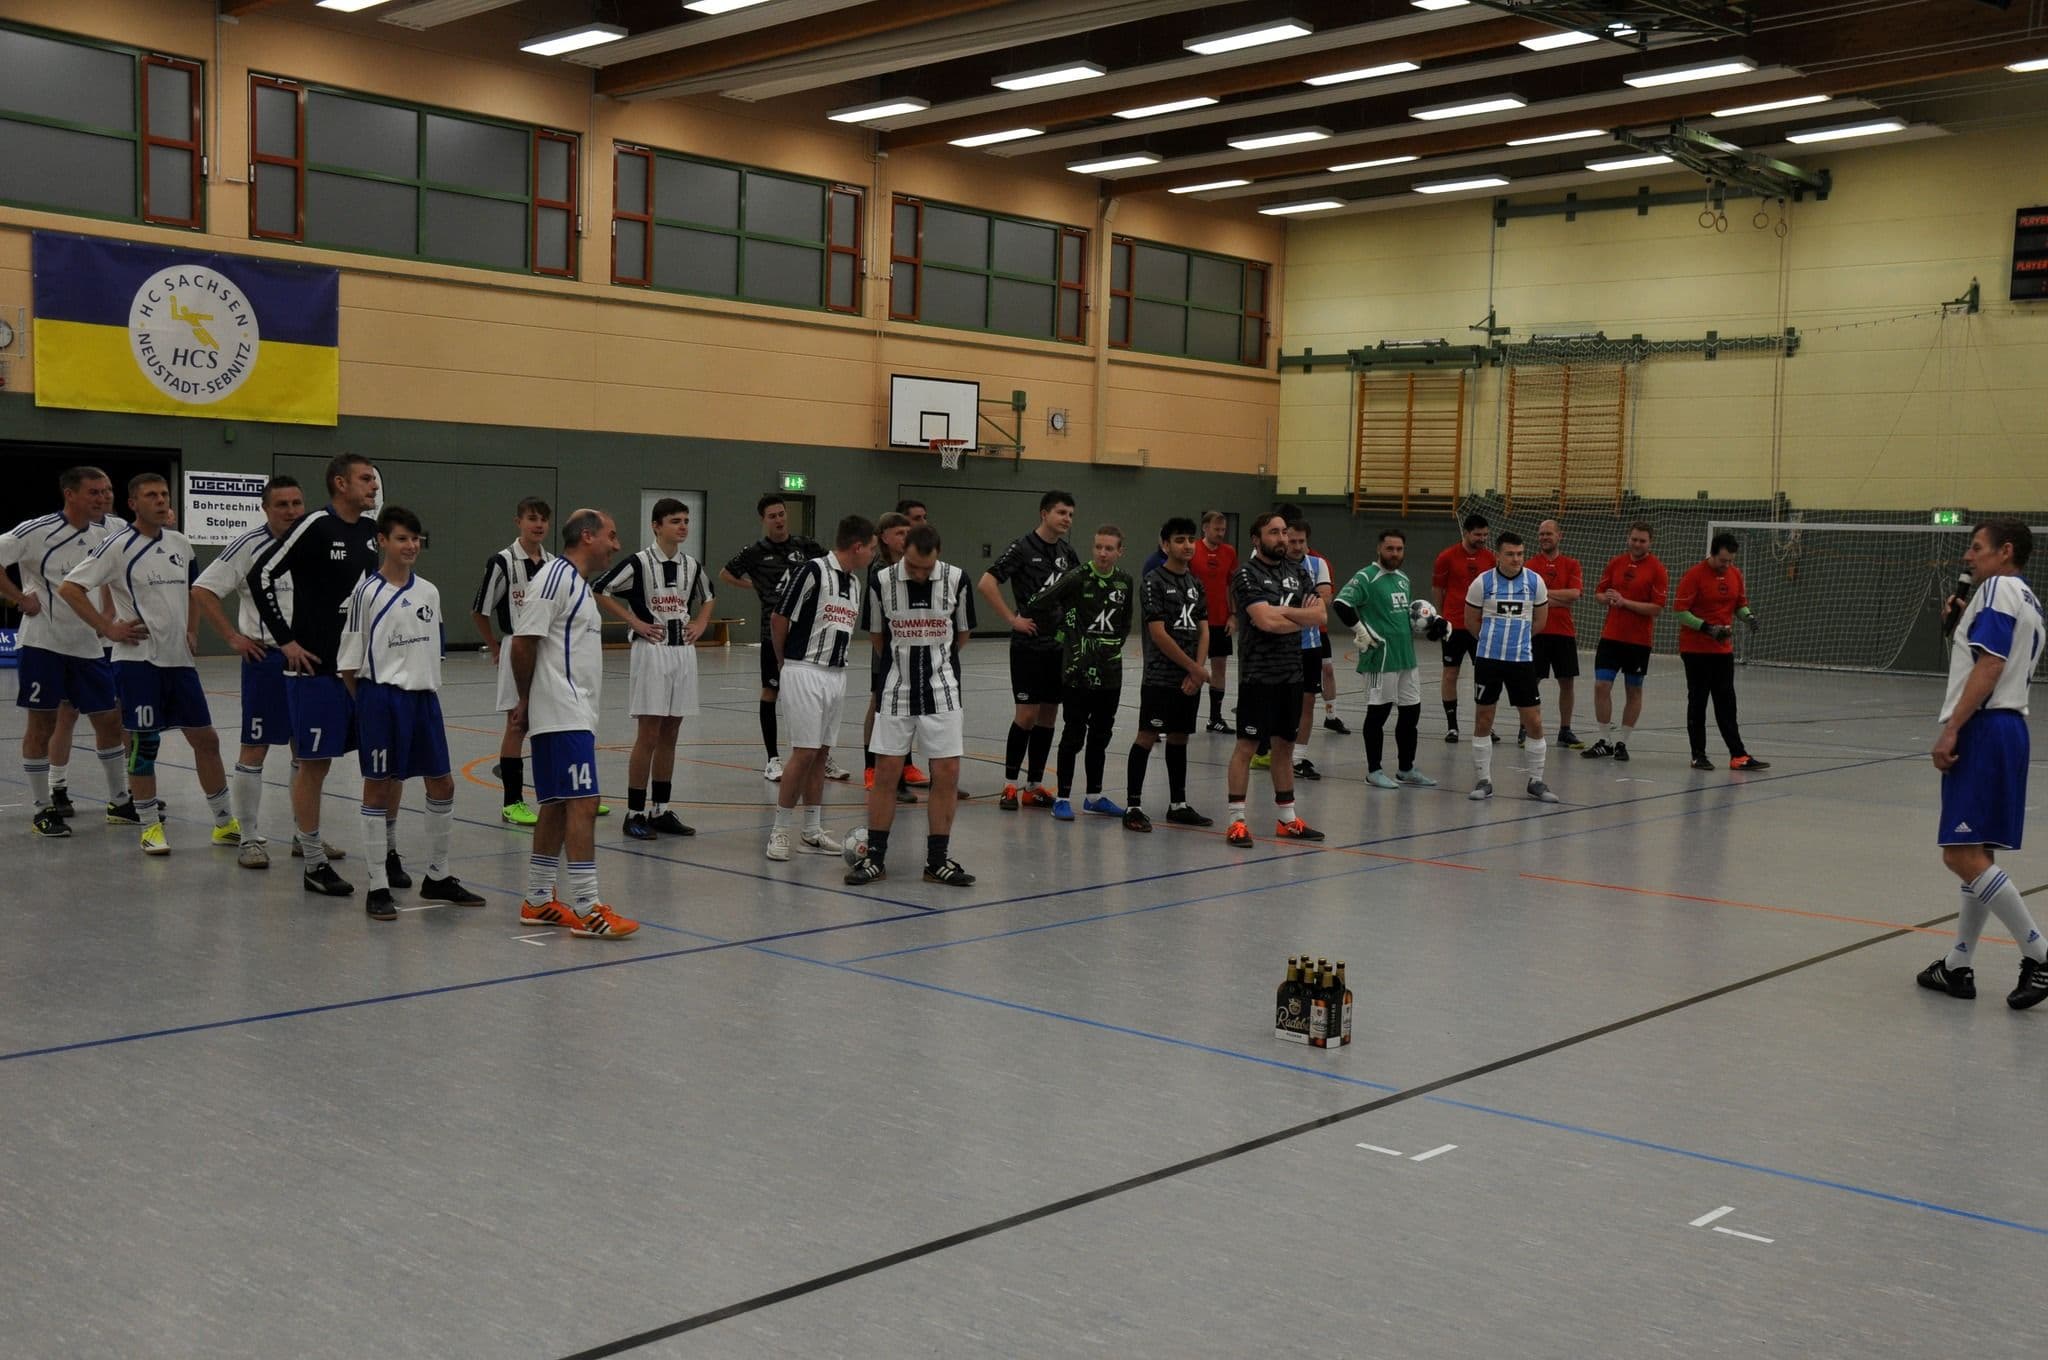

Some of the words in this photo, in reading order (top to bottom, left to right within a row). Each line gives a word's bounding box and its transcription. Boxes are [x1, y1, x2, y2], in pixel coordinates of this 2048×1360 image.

[139, 289, 162, 318] HC
[164, 274, 249, 327] SACHSEN
[138, 333, 251, 395] NEUSTADT-SEBNITZ
[172, 348, 219, 369] HCS
[193, 500, 261, 512] Bohrtechnik
[206, 517, 248, 528] Stolpen
[330, 549, 347, 560] MF
[29, 681, 41, 703] 2
[135, 705, 155, 728] 10
[251, 717, 264, 740] 5
[309, 727, 322, 752] 7
[371, 749, 388, 773] 11
[567, 762, 592, 790] 14
